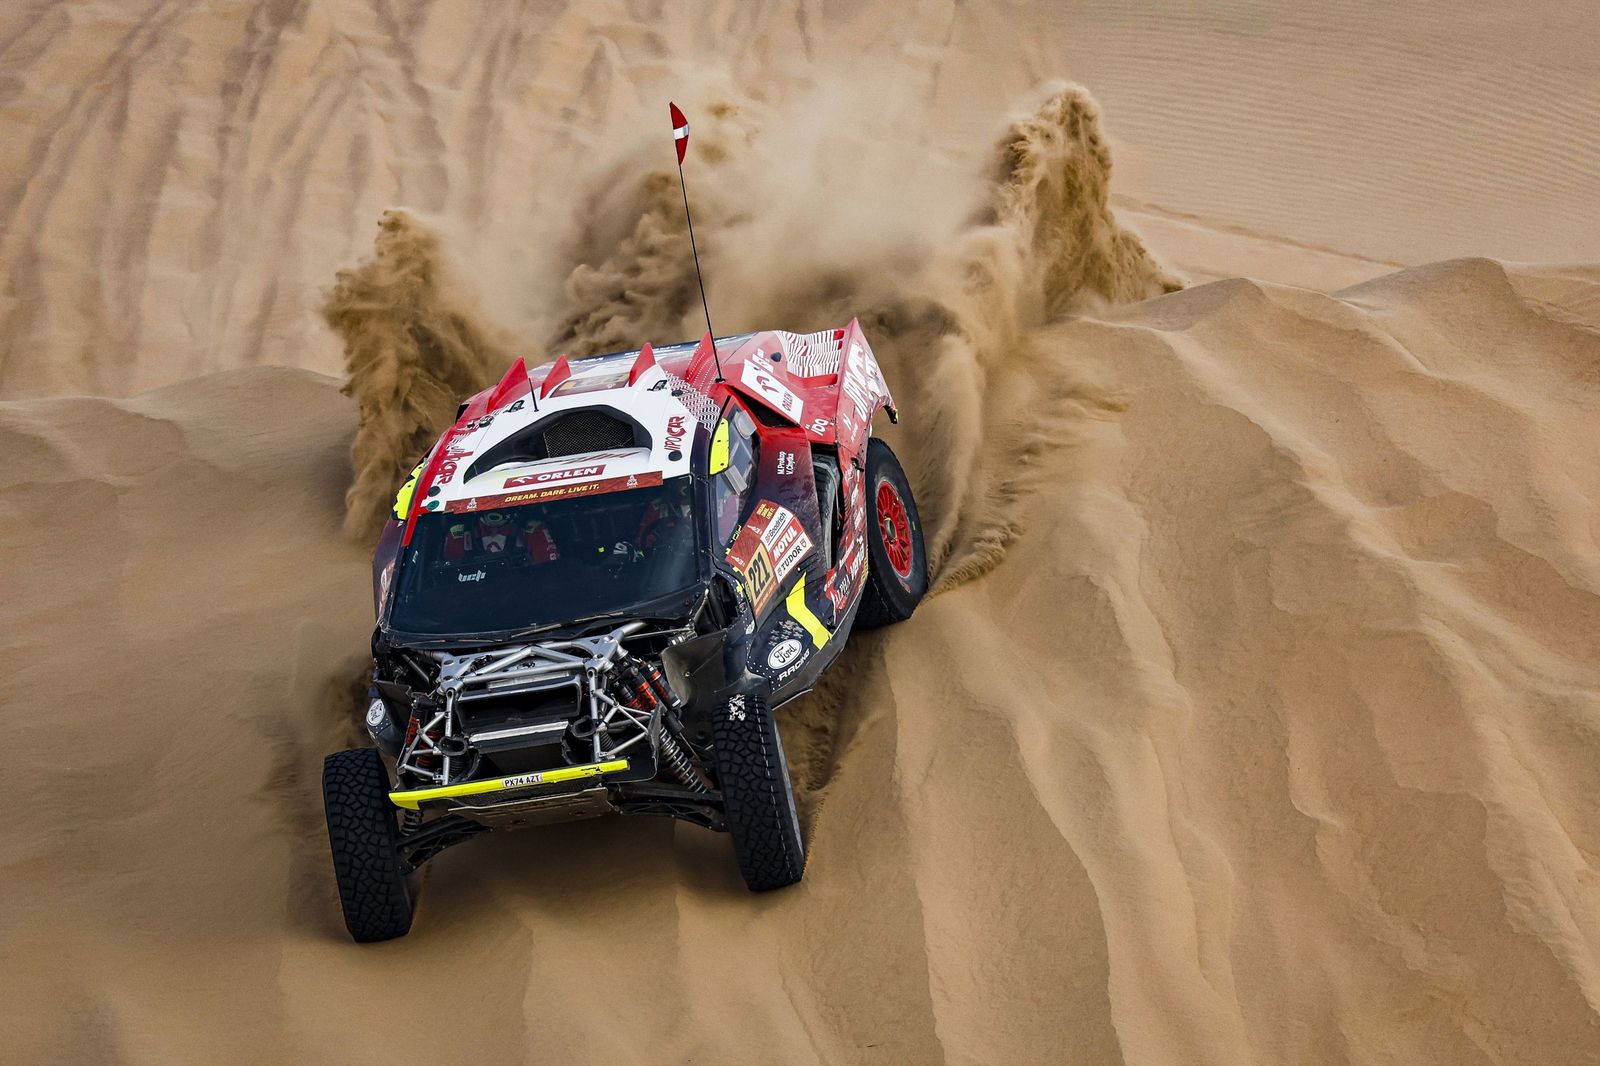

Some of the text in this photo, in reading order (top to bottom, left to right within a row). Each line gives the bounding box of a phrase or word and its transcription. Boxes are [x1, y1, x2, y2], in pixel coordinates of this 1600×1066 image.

[537, 467, 599, 481] ORLEN
[505, 493, 538, 502] DREAM.
[540, 488, 567, 498] DARE.
[568, 486, 588, 494] LIVE
[773, 525, 798, 561] MOTUL
[781, 545, 803, 571] TUDOR
[748, 551, 770, 600] 221
[773, 643, 797, 664] Ford
[504, 775, 540, 787] PX74 AZT
